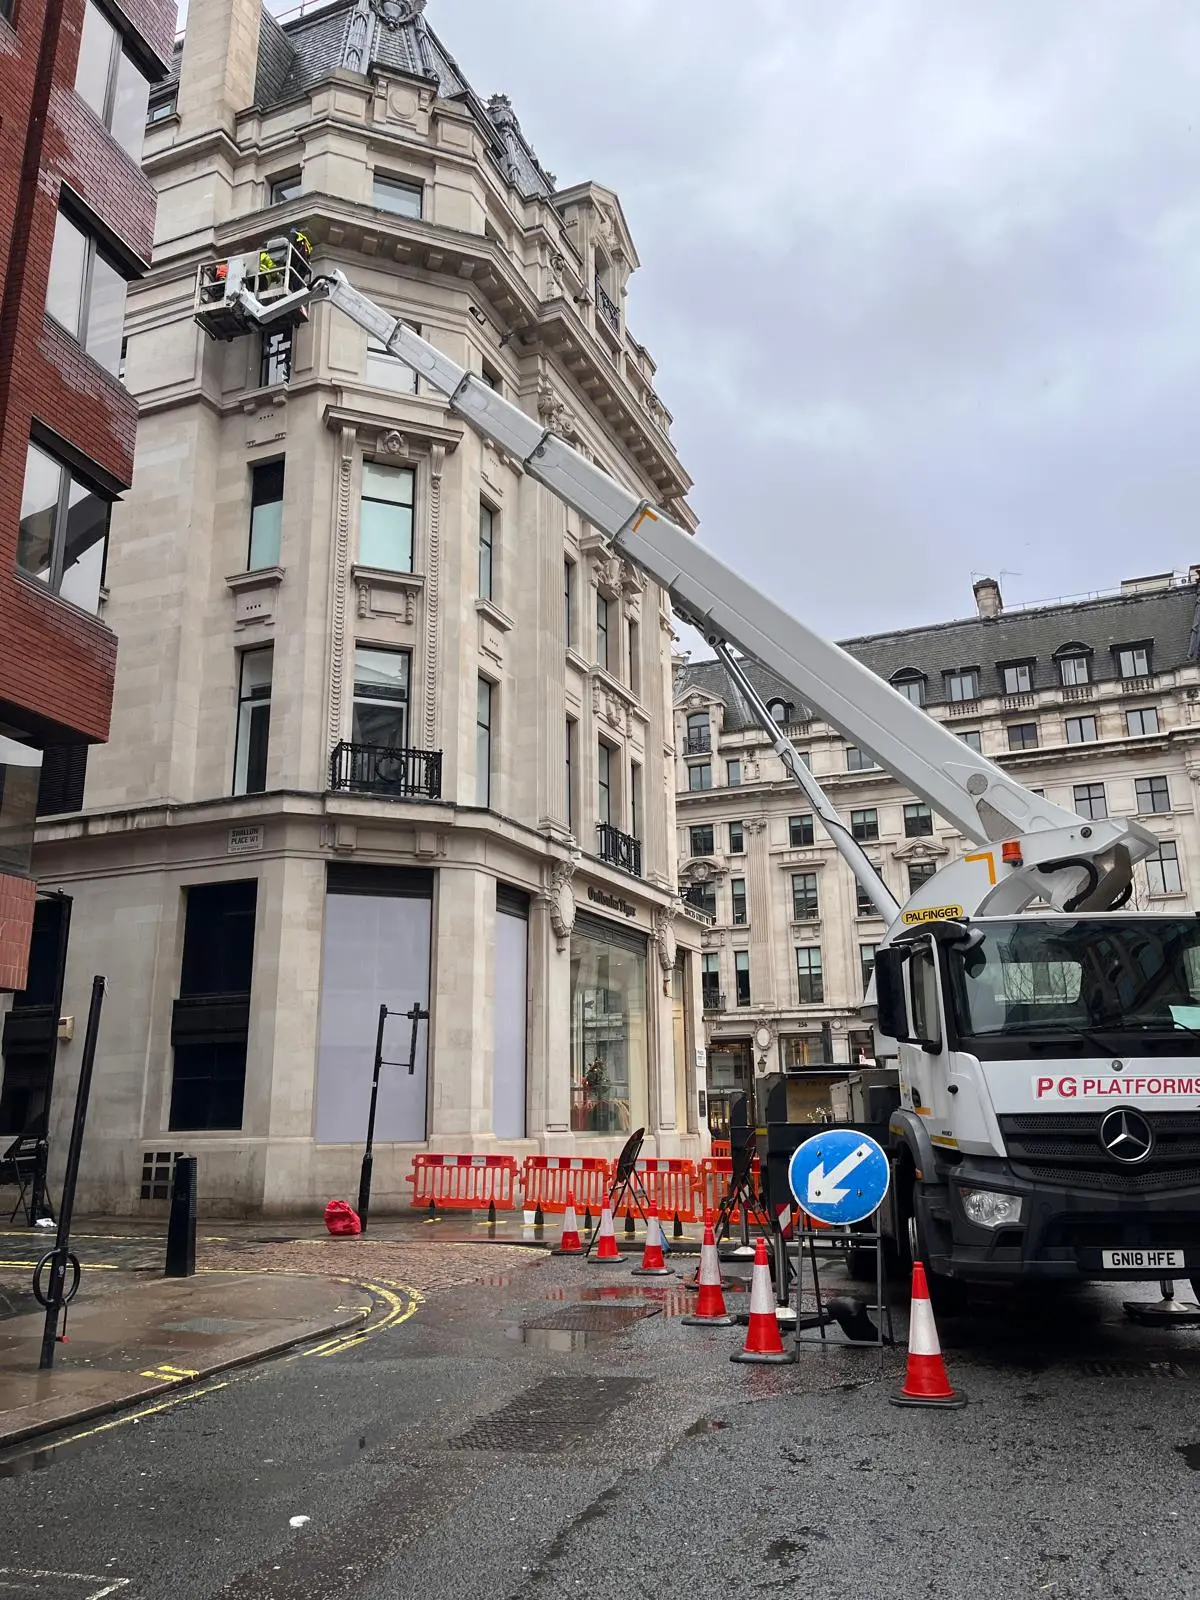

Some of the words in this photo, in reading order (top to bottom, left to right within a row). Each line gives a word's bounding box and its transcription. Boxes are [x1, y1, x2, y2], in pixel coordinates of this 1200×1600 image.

[231, 828, 258, 838] SWALLOW
[231, 836, 248, 845] PLACE
[249, 835, 258, 843] W1
[587, 886, 620, 911] Onitsuka
[618, 898, 636, 918] Tiger
[905, 907, 959, 922] PALFINGER
[1111, 1252, 1144, 1266] GN18
[1147, 1252, 1176, 1266] HFE
